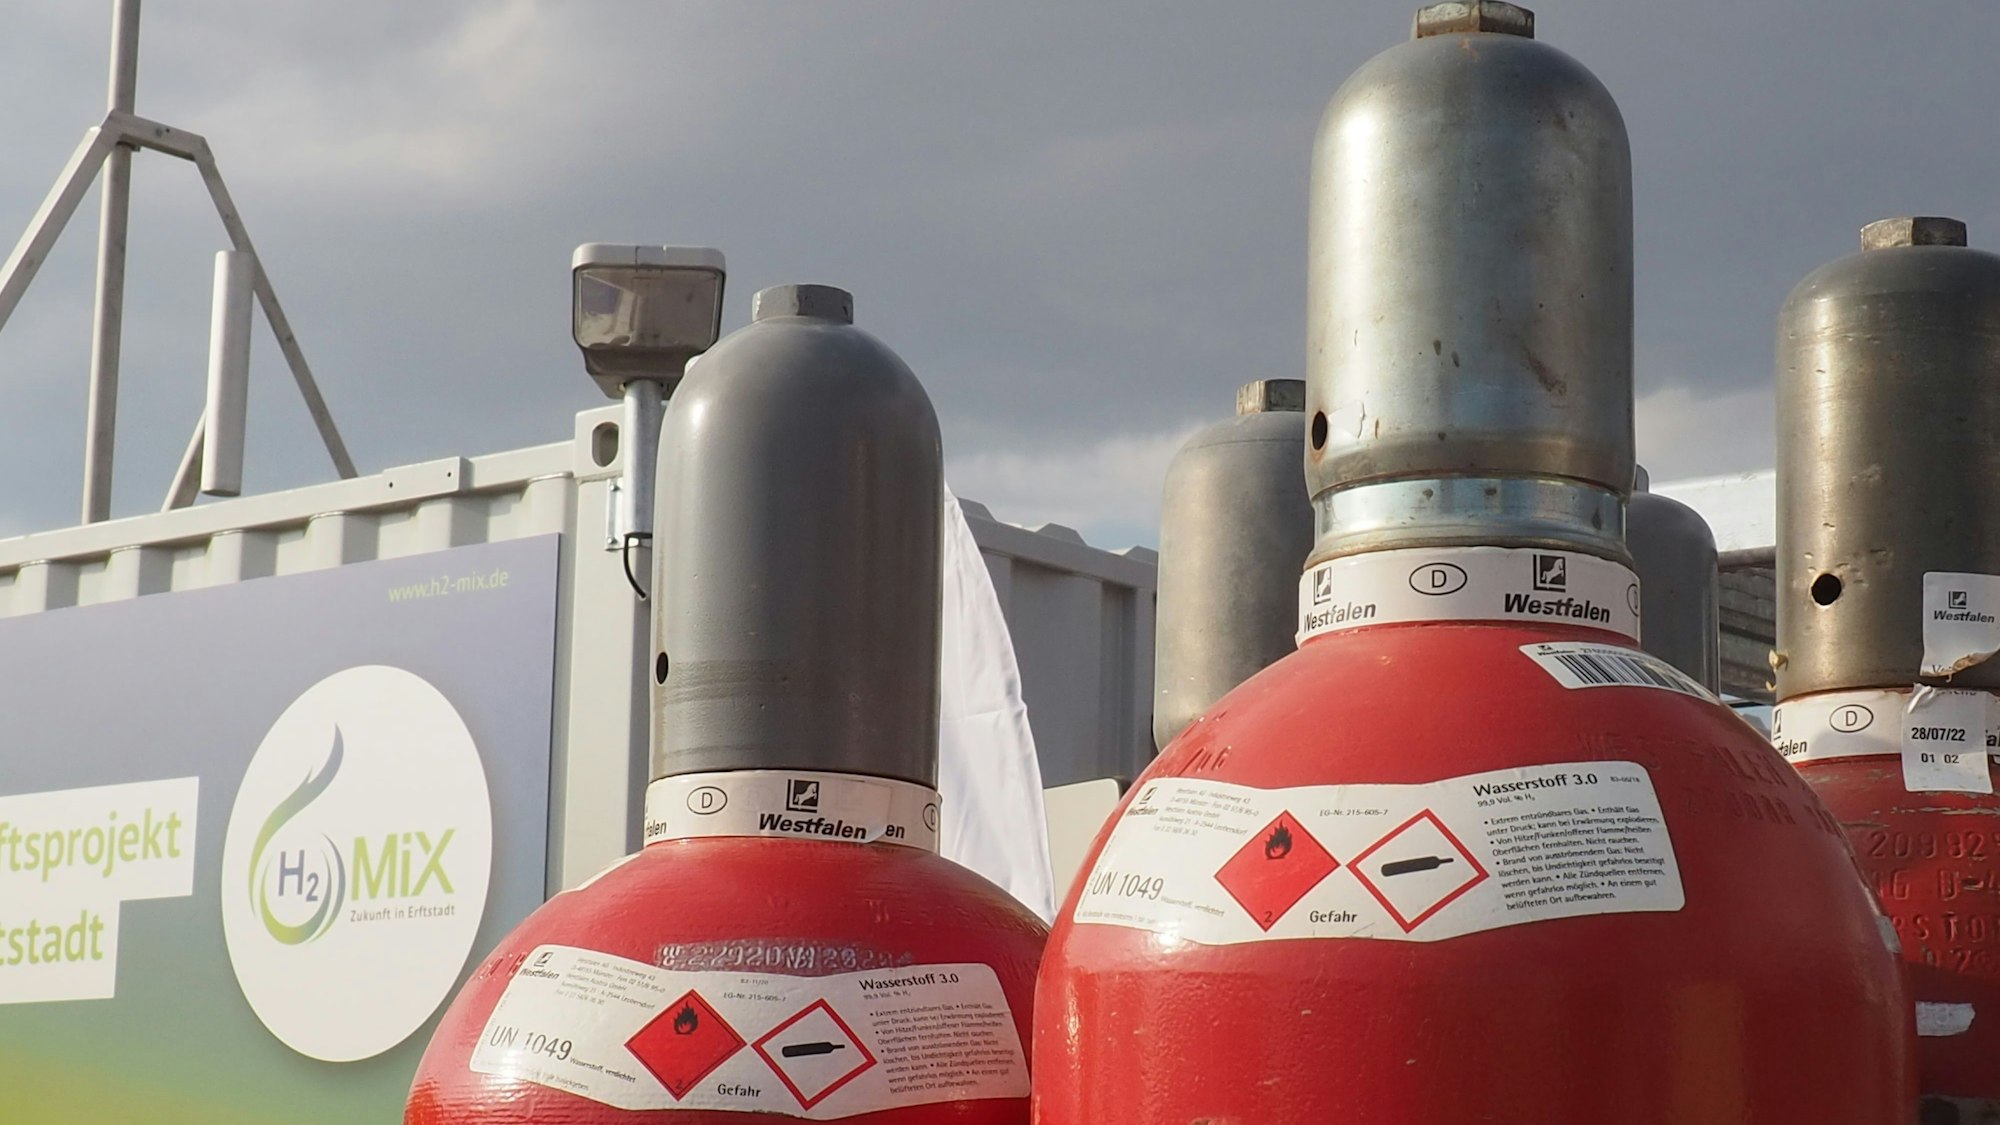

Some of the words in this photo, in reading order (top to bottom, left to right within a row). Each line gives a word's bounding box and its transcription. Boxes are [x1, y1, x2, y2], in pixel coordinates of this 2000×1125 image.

[388, 567, 509, 603] www.h2-mix.de
[1431, 570, 1447, 588] D
[1504, 593, 1611, 623] Westfalen
[1934, 610, 1995, 624] Westfalen
[1845, 710, 1858, 727] D
[1911, 727, 1966, 742] 28/07/22
[1921, 752, 1935, 763] 01
[1944, 754, 1959, 764] 02
[1473, 774, 1568, 797] Wasserstoff
[1572, 773, 1598, 785] 3.0
[701, 792, 713, 809] D
[759, 813, 867, 839] Westfalen
[1347, 809, 1389, 817] 215-605-7
[351, 828, 456, 901] MiX
[1092, 871, 1118, 896] UN
[1118, 872, 1164, 900] 1049
[350, 908, 390, 922] Zukunft
[395, 907, 405, 919] in
[408, 903, 455, 918] Erftstadt
[1263, 911, 1273, 923] 2
[1309, 910, 1358, 923] Gefahr
[859, 973, 935, 990] Wasserstoff
[938, 973, 960, 985] 3.0
[490, 1025, 519, 1047] UN
[525, 1031, 572, 1061] 1049
[717, 1083, 762, 1098] Gefahr
